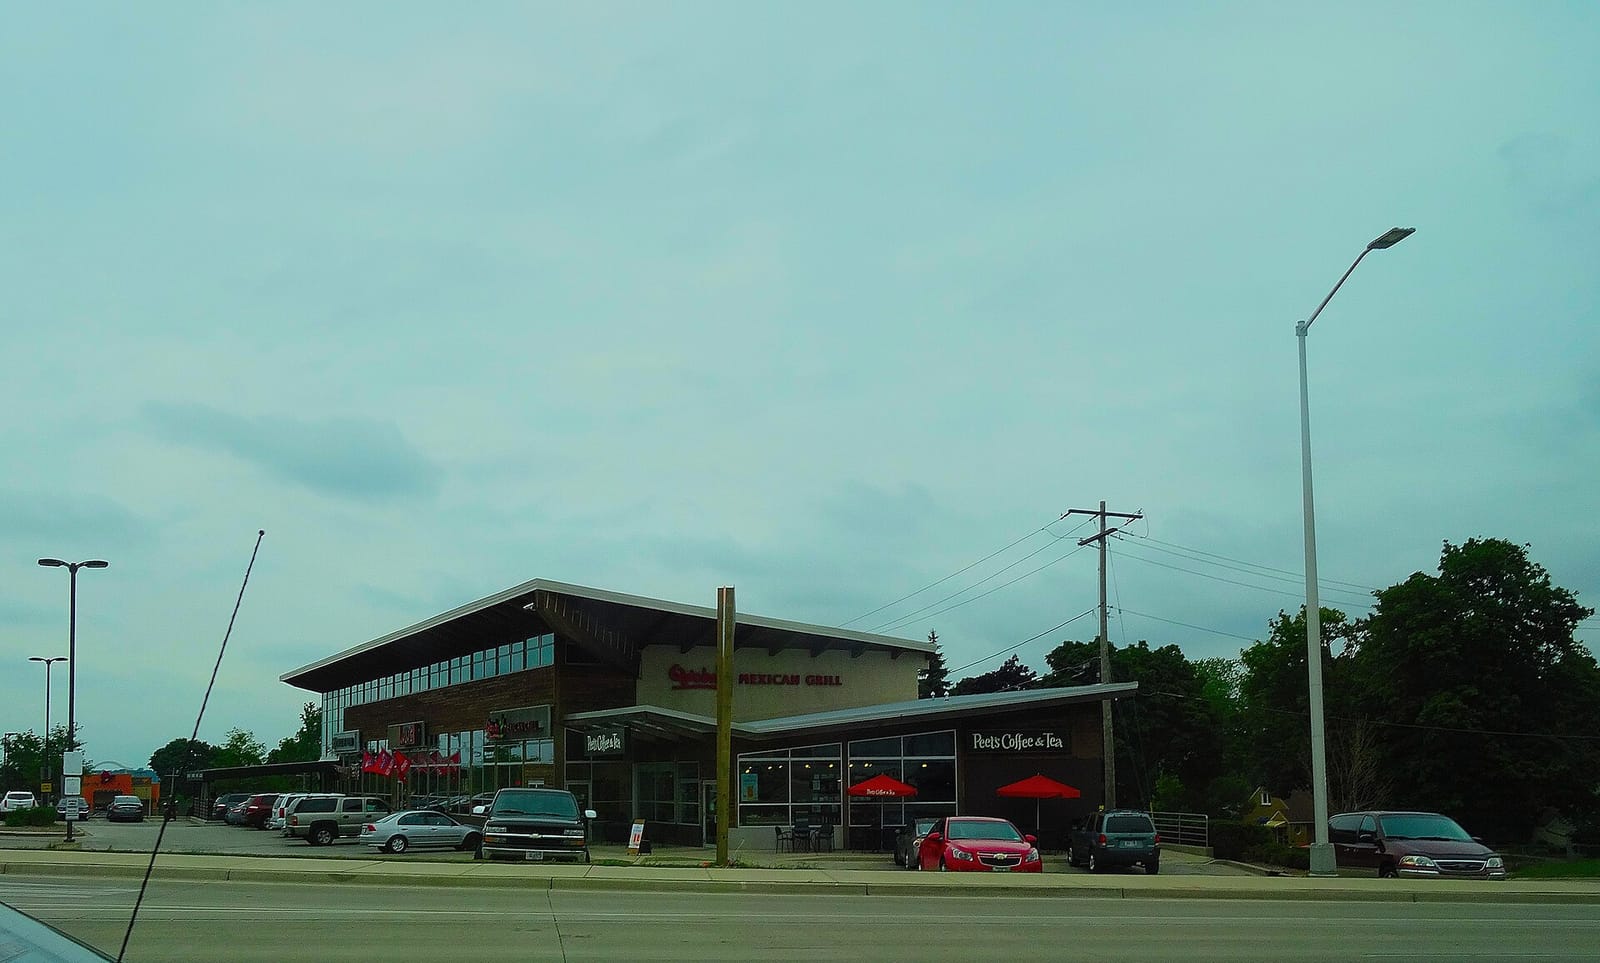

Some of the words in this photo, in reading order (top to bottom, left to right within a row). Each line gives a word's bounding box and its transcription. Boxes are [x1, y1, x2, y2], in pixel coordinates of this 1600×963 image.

[738, 673, 801, 685] MEXICAN
[805, 675, 843, 686] GRILL
[1001, 733, 1033, 751] Coffee
[1035, 737, 1044, 747] &
[1042, 732, 1064, 748] Tea
